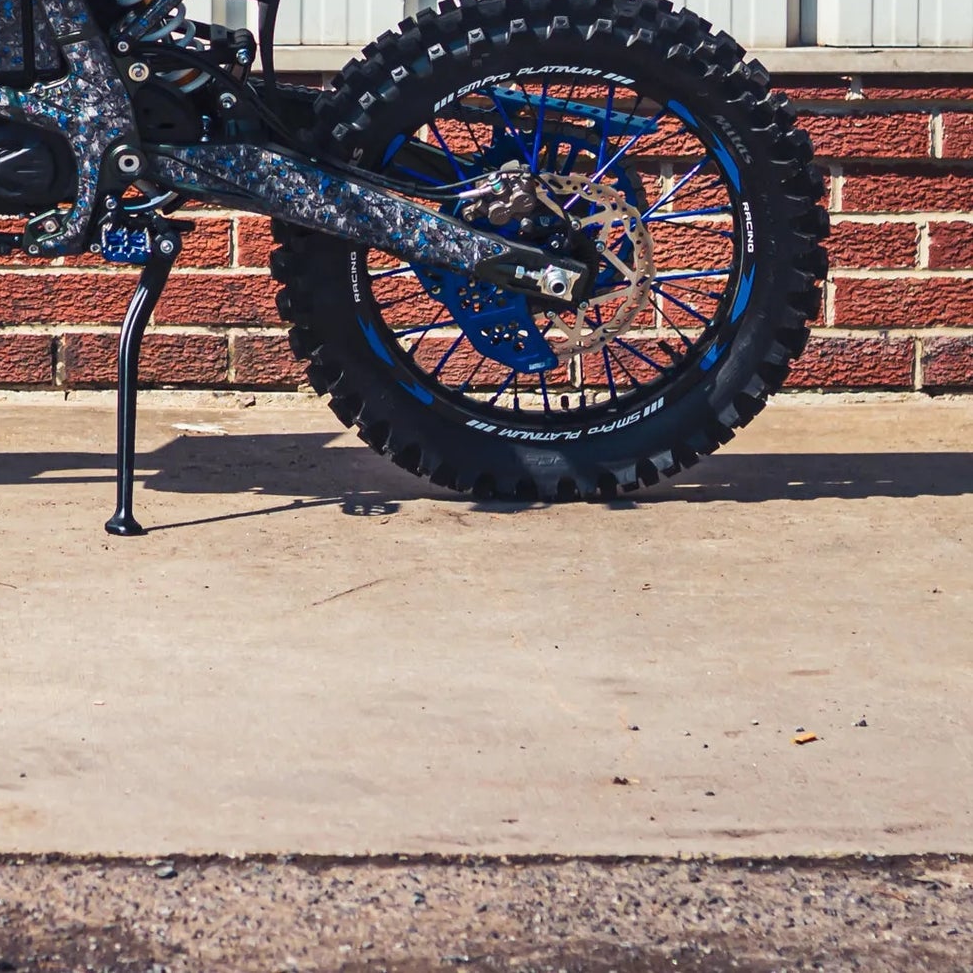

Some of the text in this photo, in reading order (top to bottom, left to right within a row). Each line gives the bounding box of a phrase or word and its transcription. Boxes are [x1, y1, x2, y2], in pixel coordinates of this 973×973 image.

[516, 65, 602, 77] PLATINUM
[742, 201, 755, 254] RACING
[350, 251, 361, 303] RACING
[497, 427, 583, 441] PLATINUM
